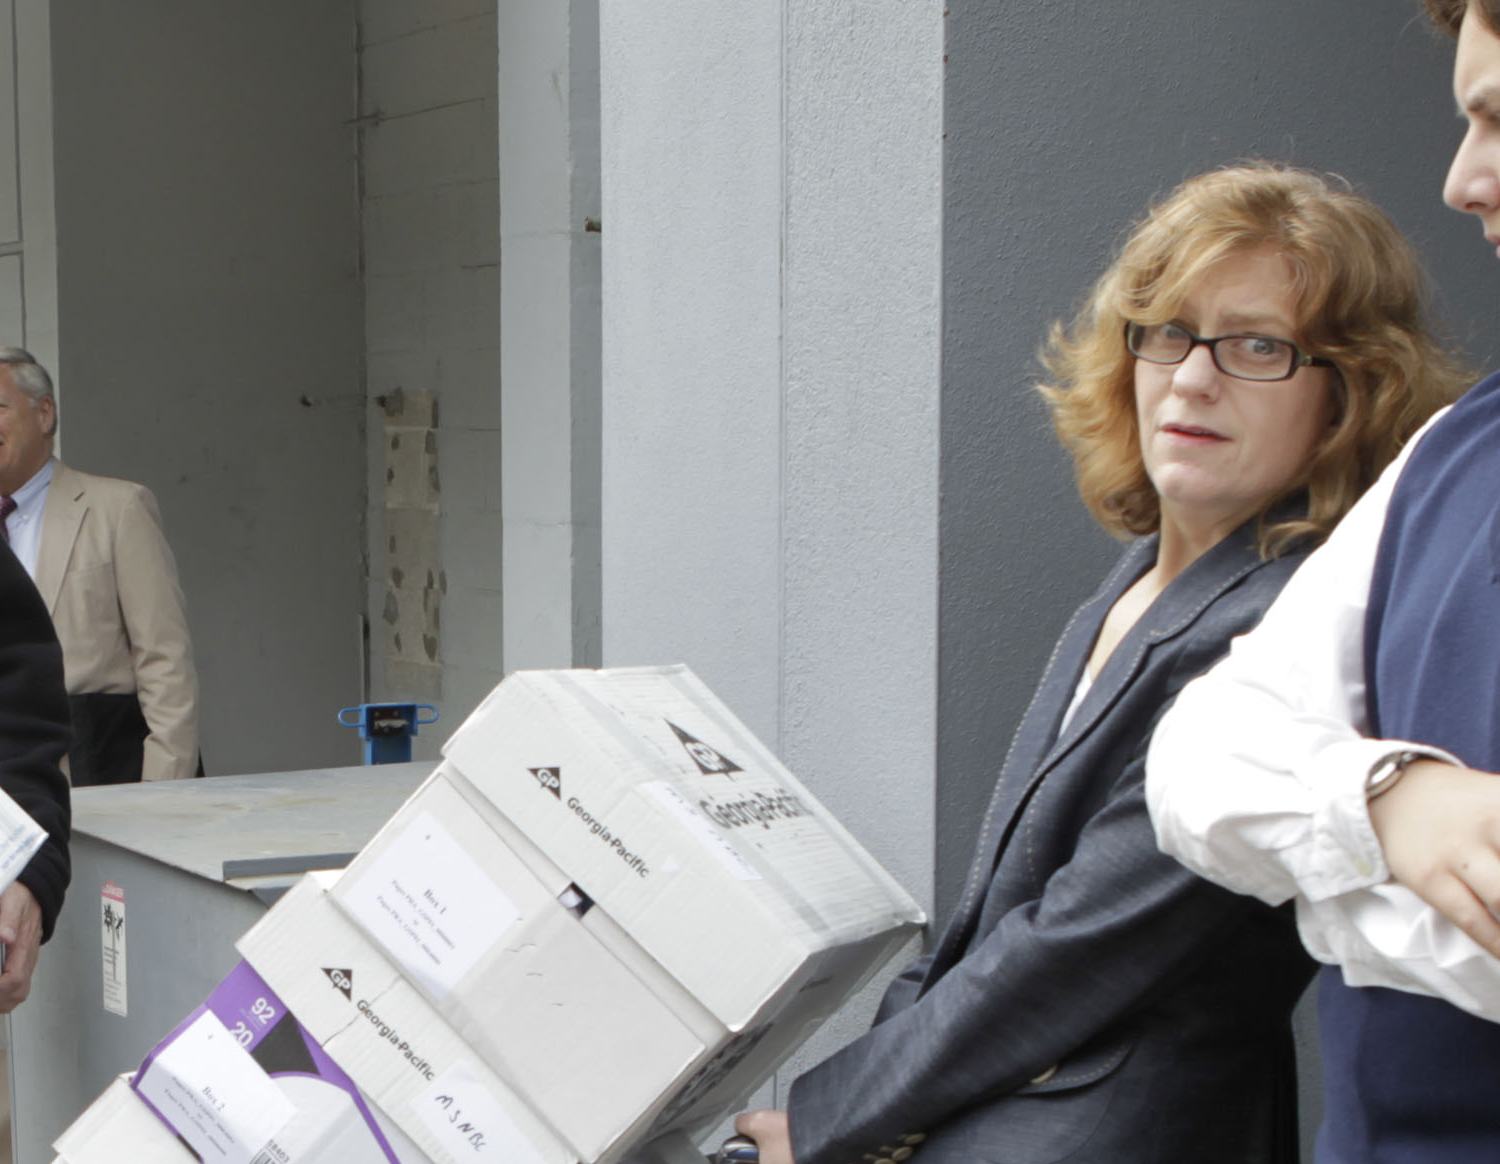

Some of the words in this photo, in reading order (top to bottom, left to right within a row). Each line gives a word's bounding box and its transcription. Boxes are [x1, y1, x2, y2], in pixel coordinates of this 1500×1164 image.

[536, 768, 560, 789] GP
[566, 796, 650, 878] Georgia-Pacific
[424, 889, 439, 908] Box
[329, 969, 351, 991] GP
[251, 997, 276, 1026] 92
[356, 999, 436, 1082] Georgia-Pacific
[202, 1086, 218, 1106] Box
